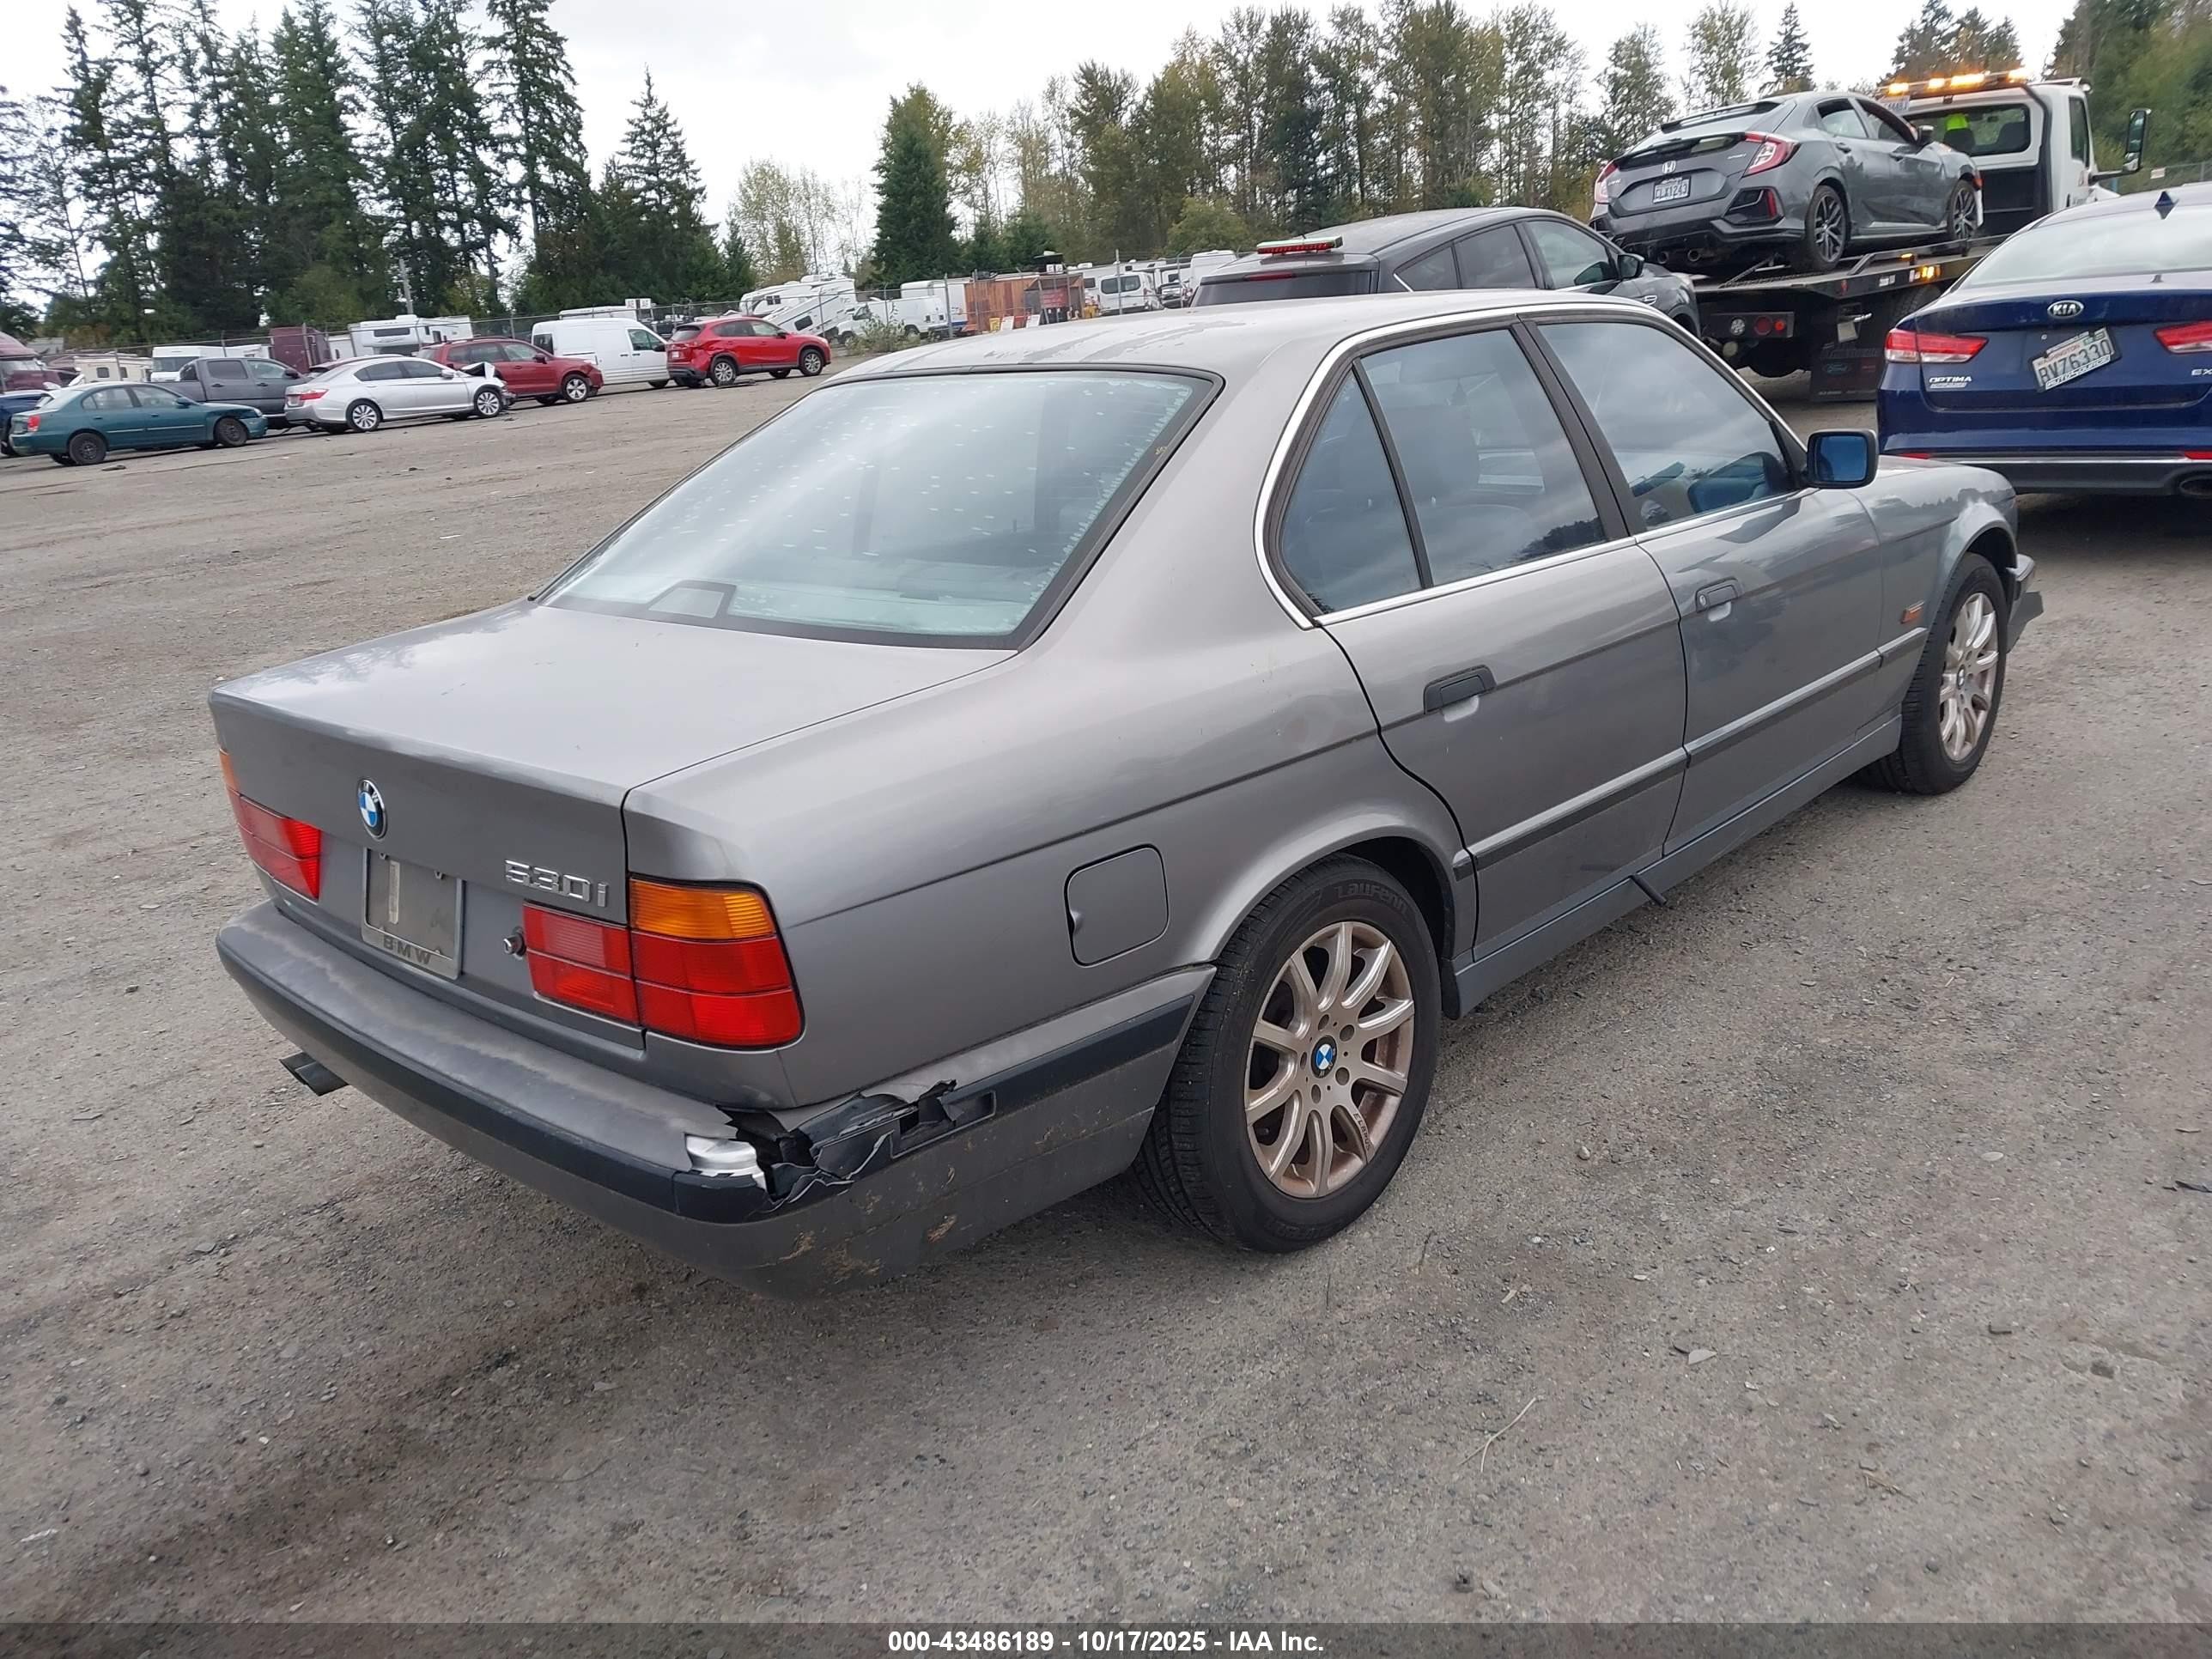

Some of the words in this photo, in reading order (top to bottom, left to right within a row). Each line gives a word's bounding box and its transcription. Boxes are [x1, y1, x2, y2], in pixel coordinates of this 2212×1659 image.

[2053, 303, 2077, 315] KIA
[505, 860, 606, 907] 530i
[383, 934, 430, 965] BMW
